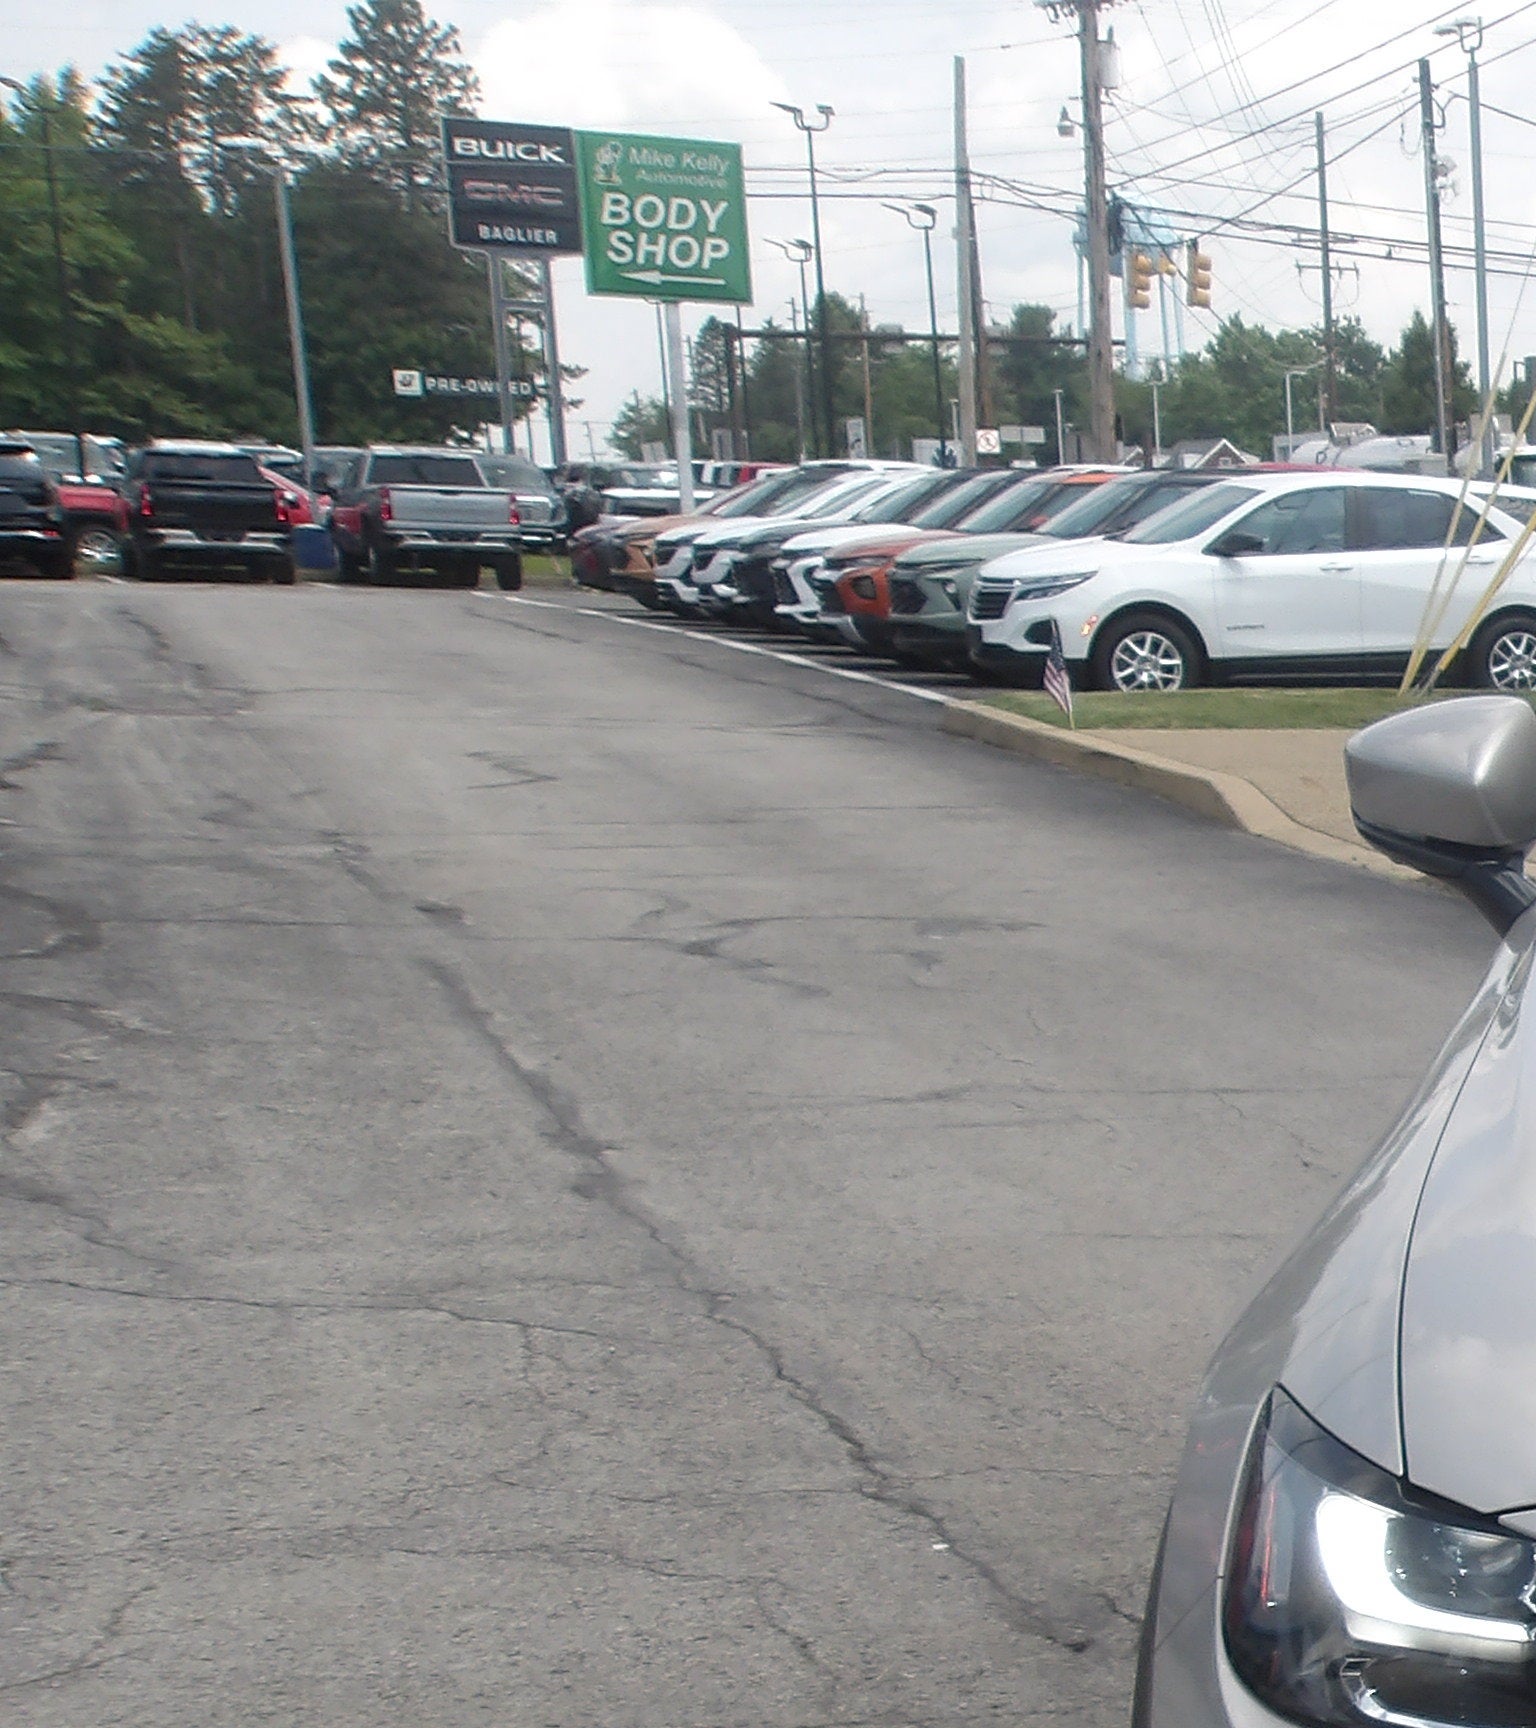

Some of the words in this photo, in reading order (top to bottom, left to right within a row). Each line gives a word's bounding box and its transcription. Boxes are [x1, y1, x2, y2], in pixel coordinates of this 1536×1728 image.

[452, 136, 566, 163] BUICK
[628, 146, 676, 168] Mike
[681, 152, 730, 177] Kelly
[463, 178, 564, 206] GMC
[635, 168, 728, 189] Automotive
[601, 191, 729, 233] BODY
[477, 222, 558, 245] BAGLIER
[606, 229, 730, 270] SHOP
